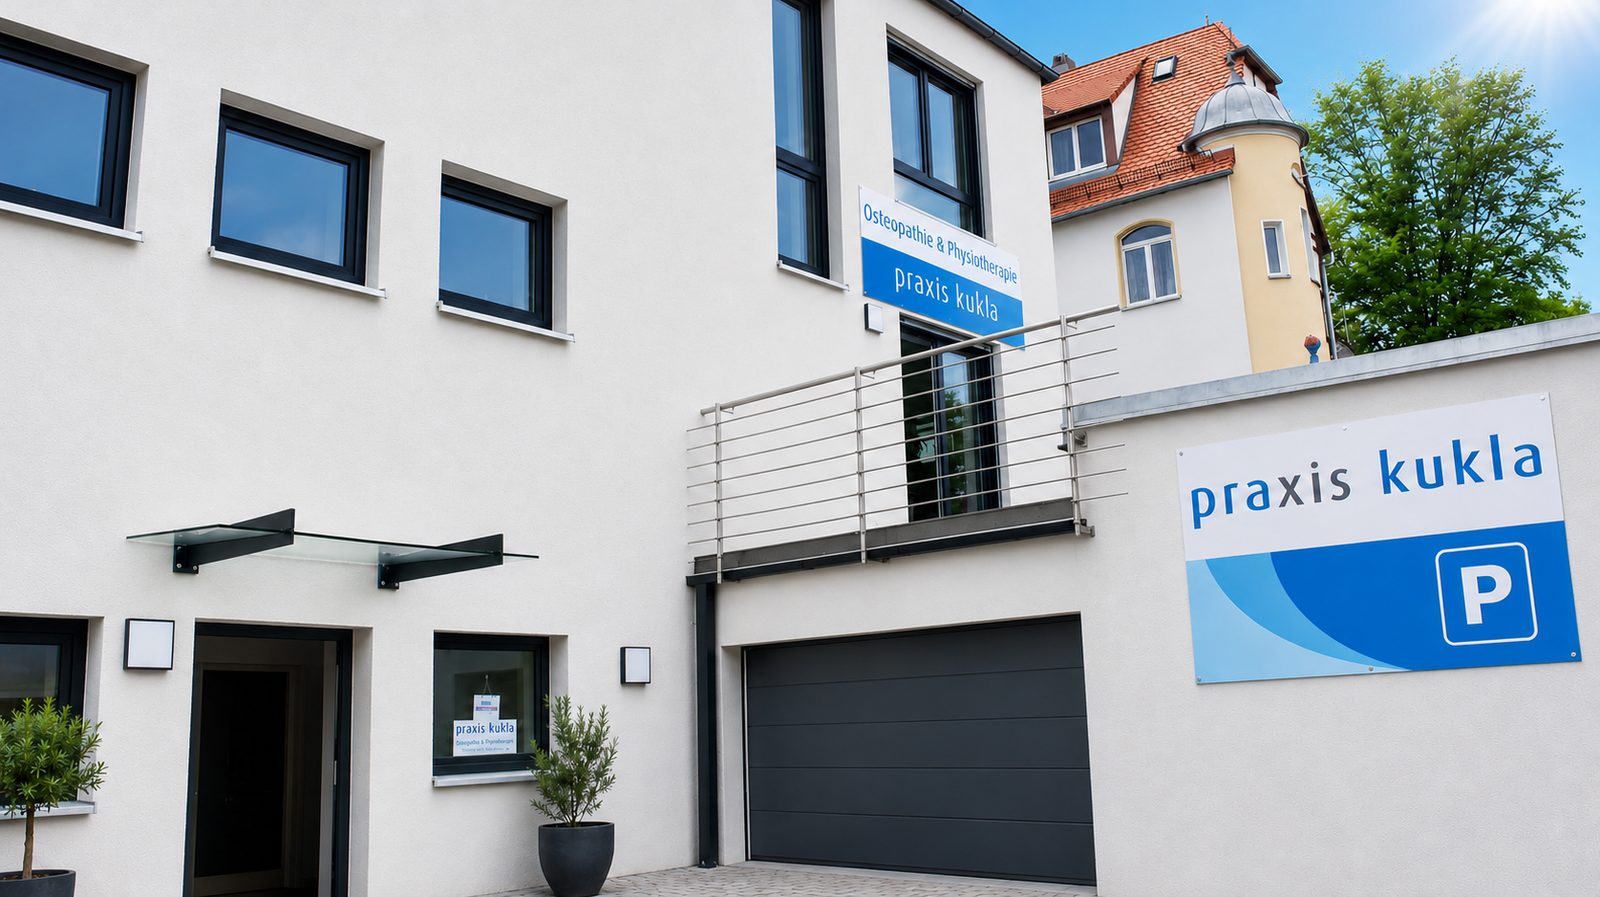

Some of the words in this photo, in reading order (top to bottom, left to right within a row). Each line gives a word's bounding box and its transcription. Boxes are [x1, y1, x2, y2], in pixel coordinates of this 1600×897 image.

[863, 203, 934, 248] Osteopathie
[936, 236, 945, 253] &
[948, 240, 1017, 284] Physiotherapie
[895, 267, 949, 304] praxis
[955, 283, 998, 322] kukla
[1190, 461, 1351, 530] praxis
[1379, 433, 1544, 495] kukla
[1460, 563, 1513, 625] P
[456, 722, 485, 736] praxis
[489, 722, 514, 733] kukla
